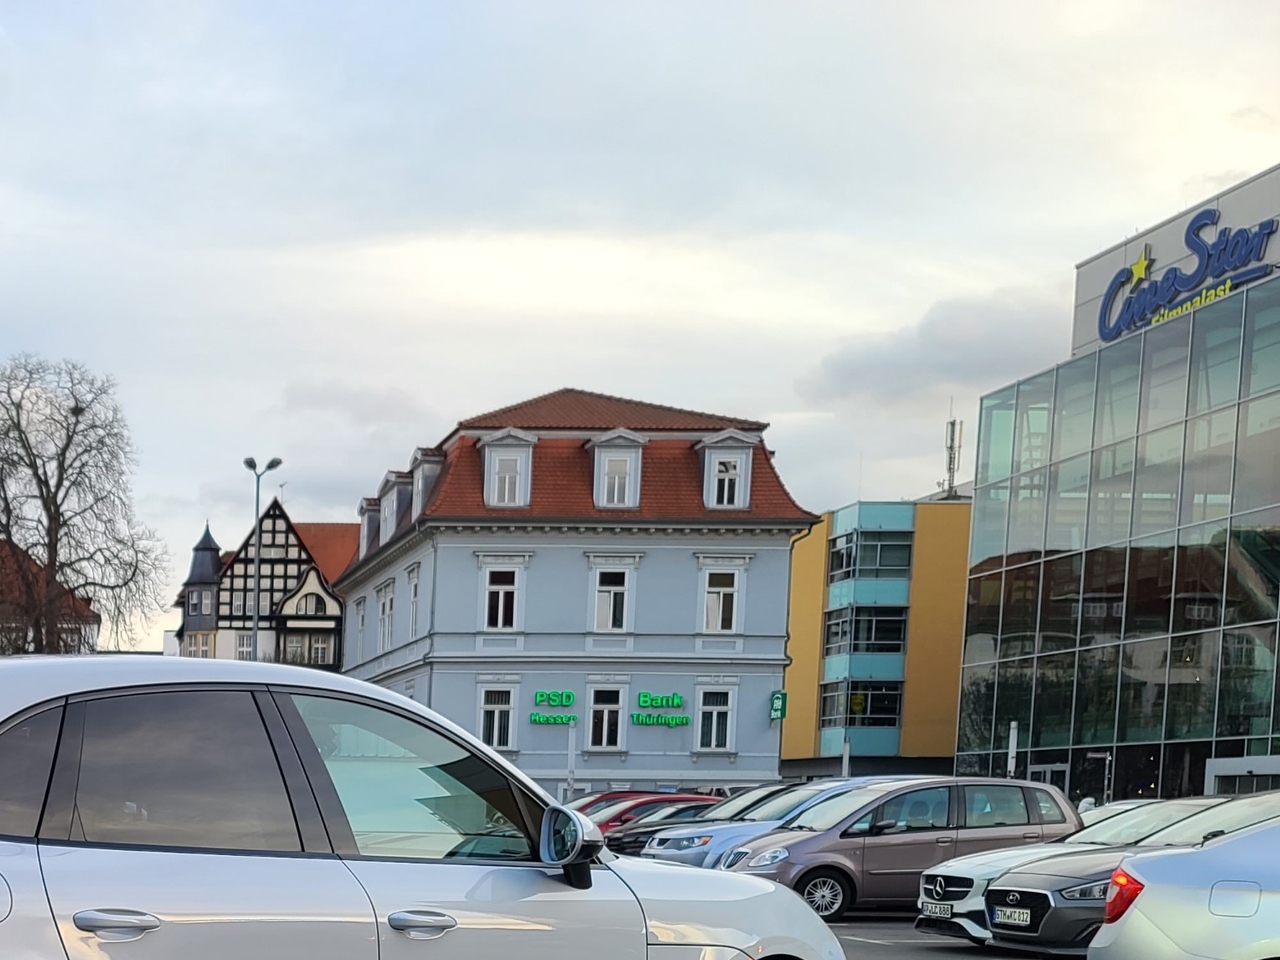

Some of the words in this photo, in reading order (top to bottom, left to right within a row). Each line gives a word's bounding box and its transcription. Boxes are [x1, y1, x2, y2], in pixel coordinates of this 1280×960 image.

[1098, 208, 1278, 342] CineStar
[535, 690, 576, 707] PSD
[638, 692, 684, 708] Bank
[631, 712, 692, 728] Thüringen
